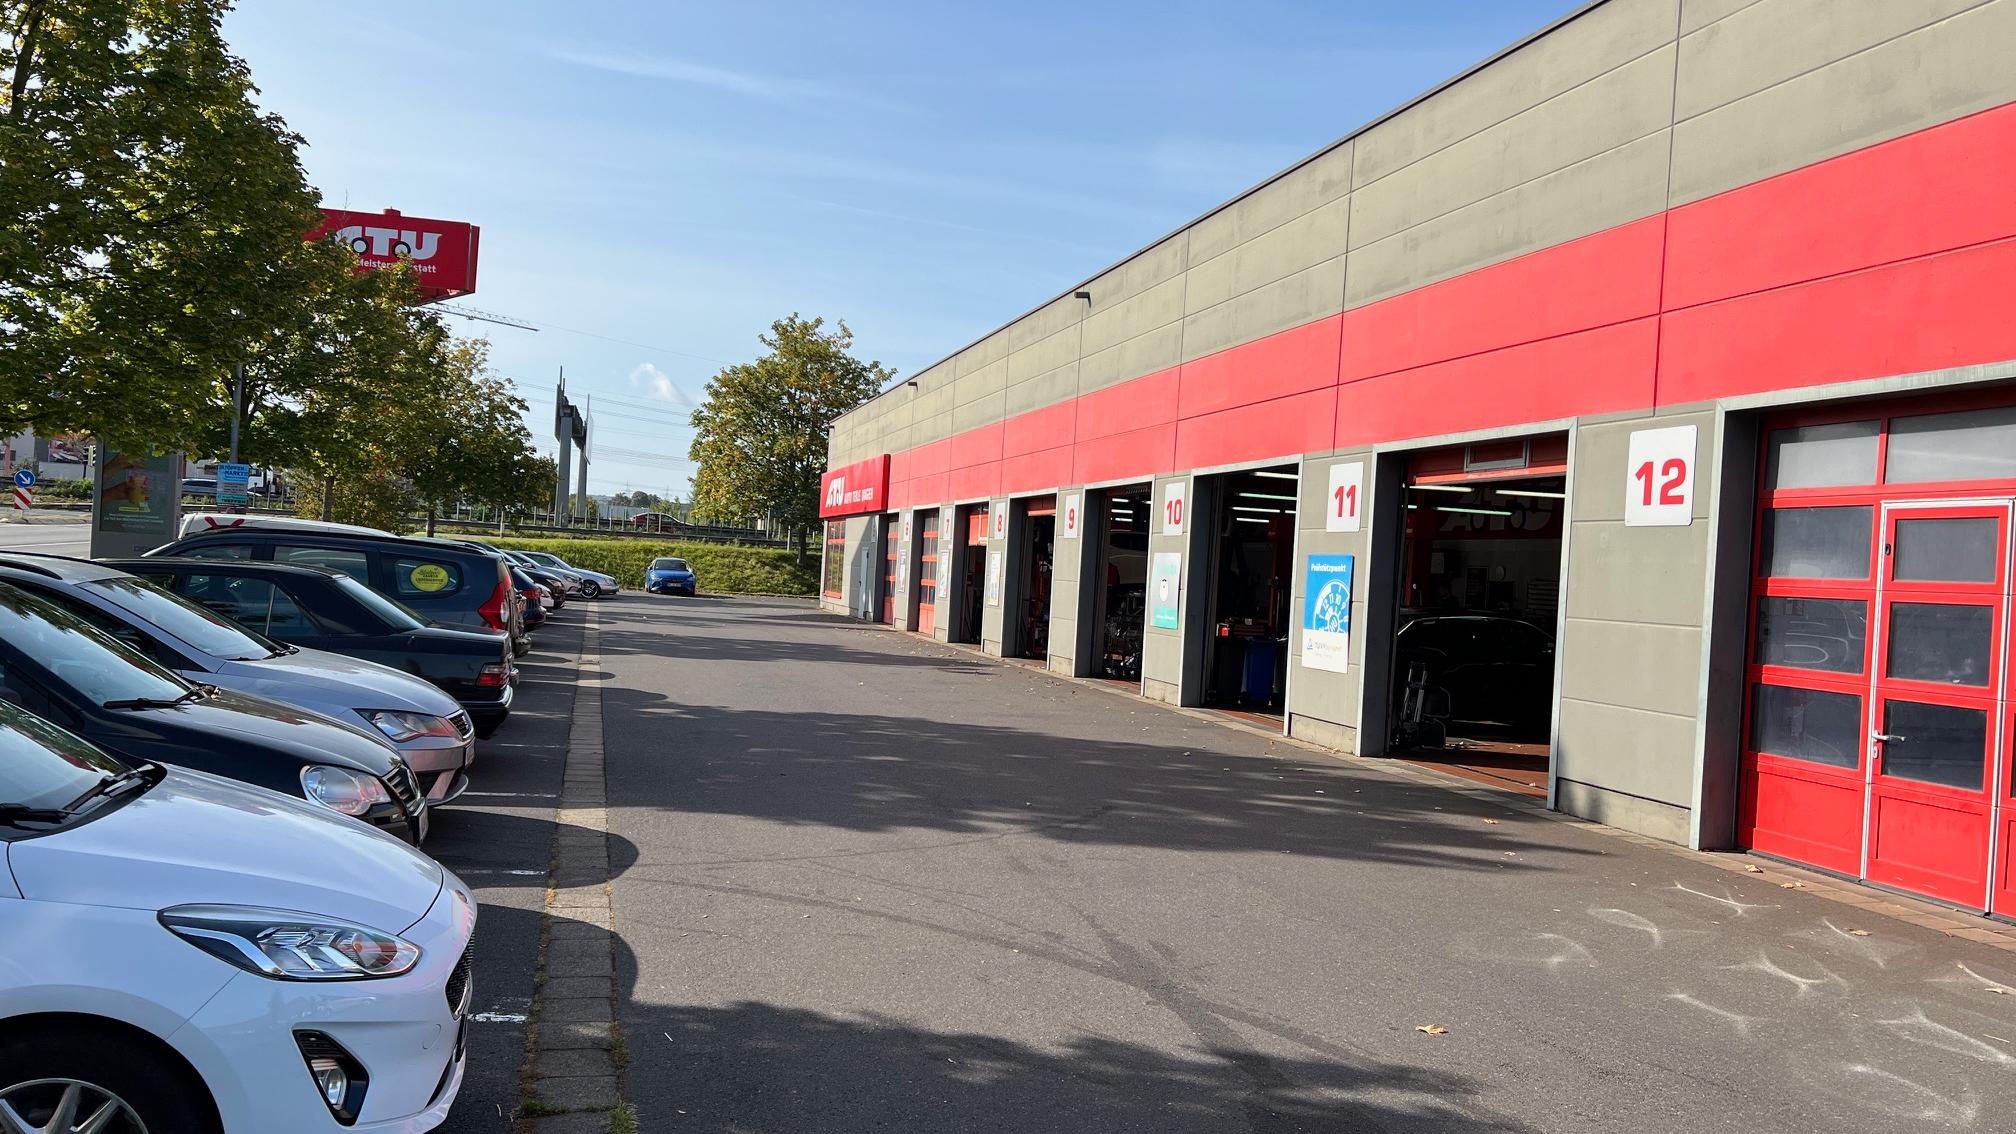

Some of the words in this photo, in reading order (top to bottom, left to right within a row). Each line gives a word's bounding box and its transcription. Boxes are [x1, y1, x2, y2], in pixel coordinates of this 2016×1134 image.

[335, 226, 442, 260] ATU
[825, 476, 846, 509] ATU
[1635, 458, 1687, 506] 12
[1166, 499, 1182, 525] 10
[1334, 485, 1356, 518] 11
[997, 514, 1003, 532] 8
[1068, 508, 1075, 530] 9
